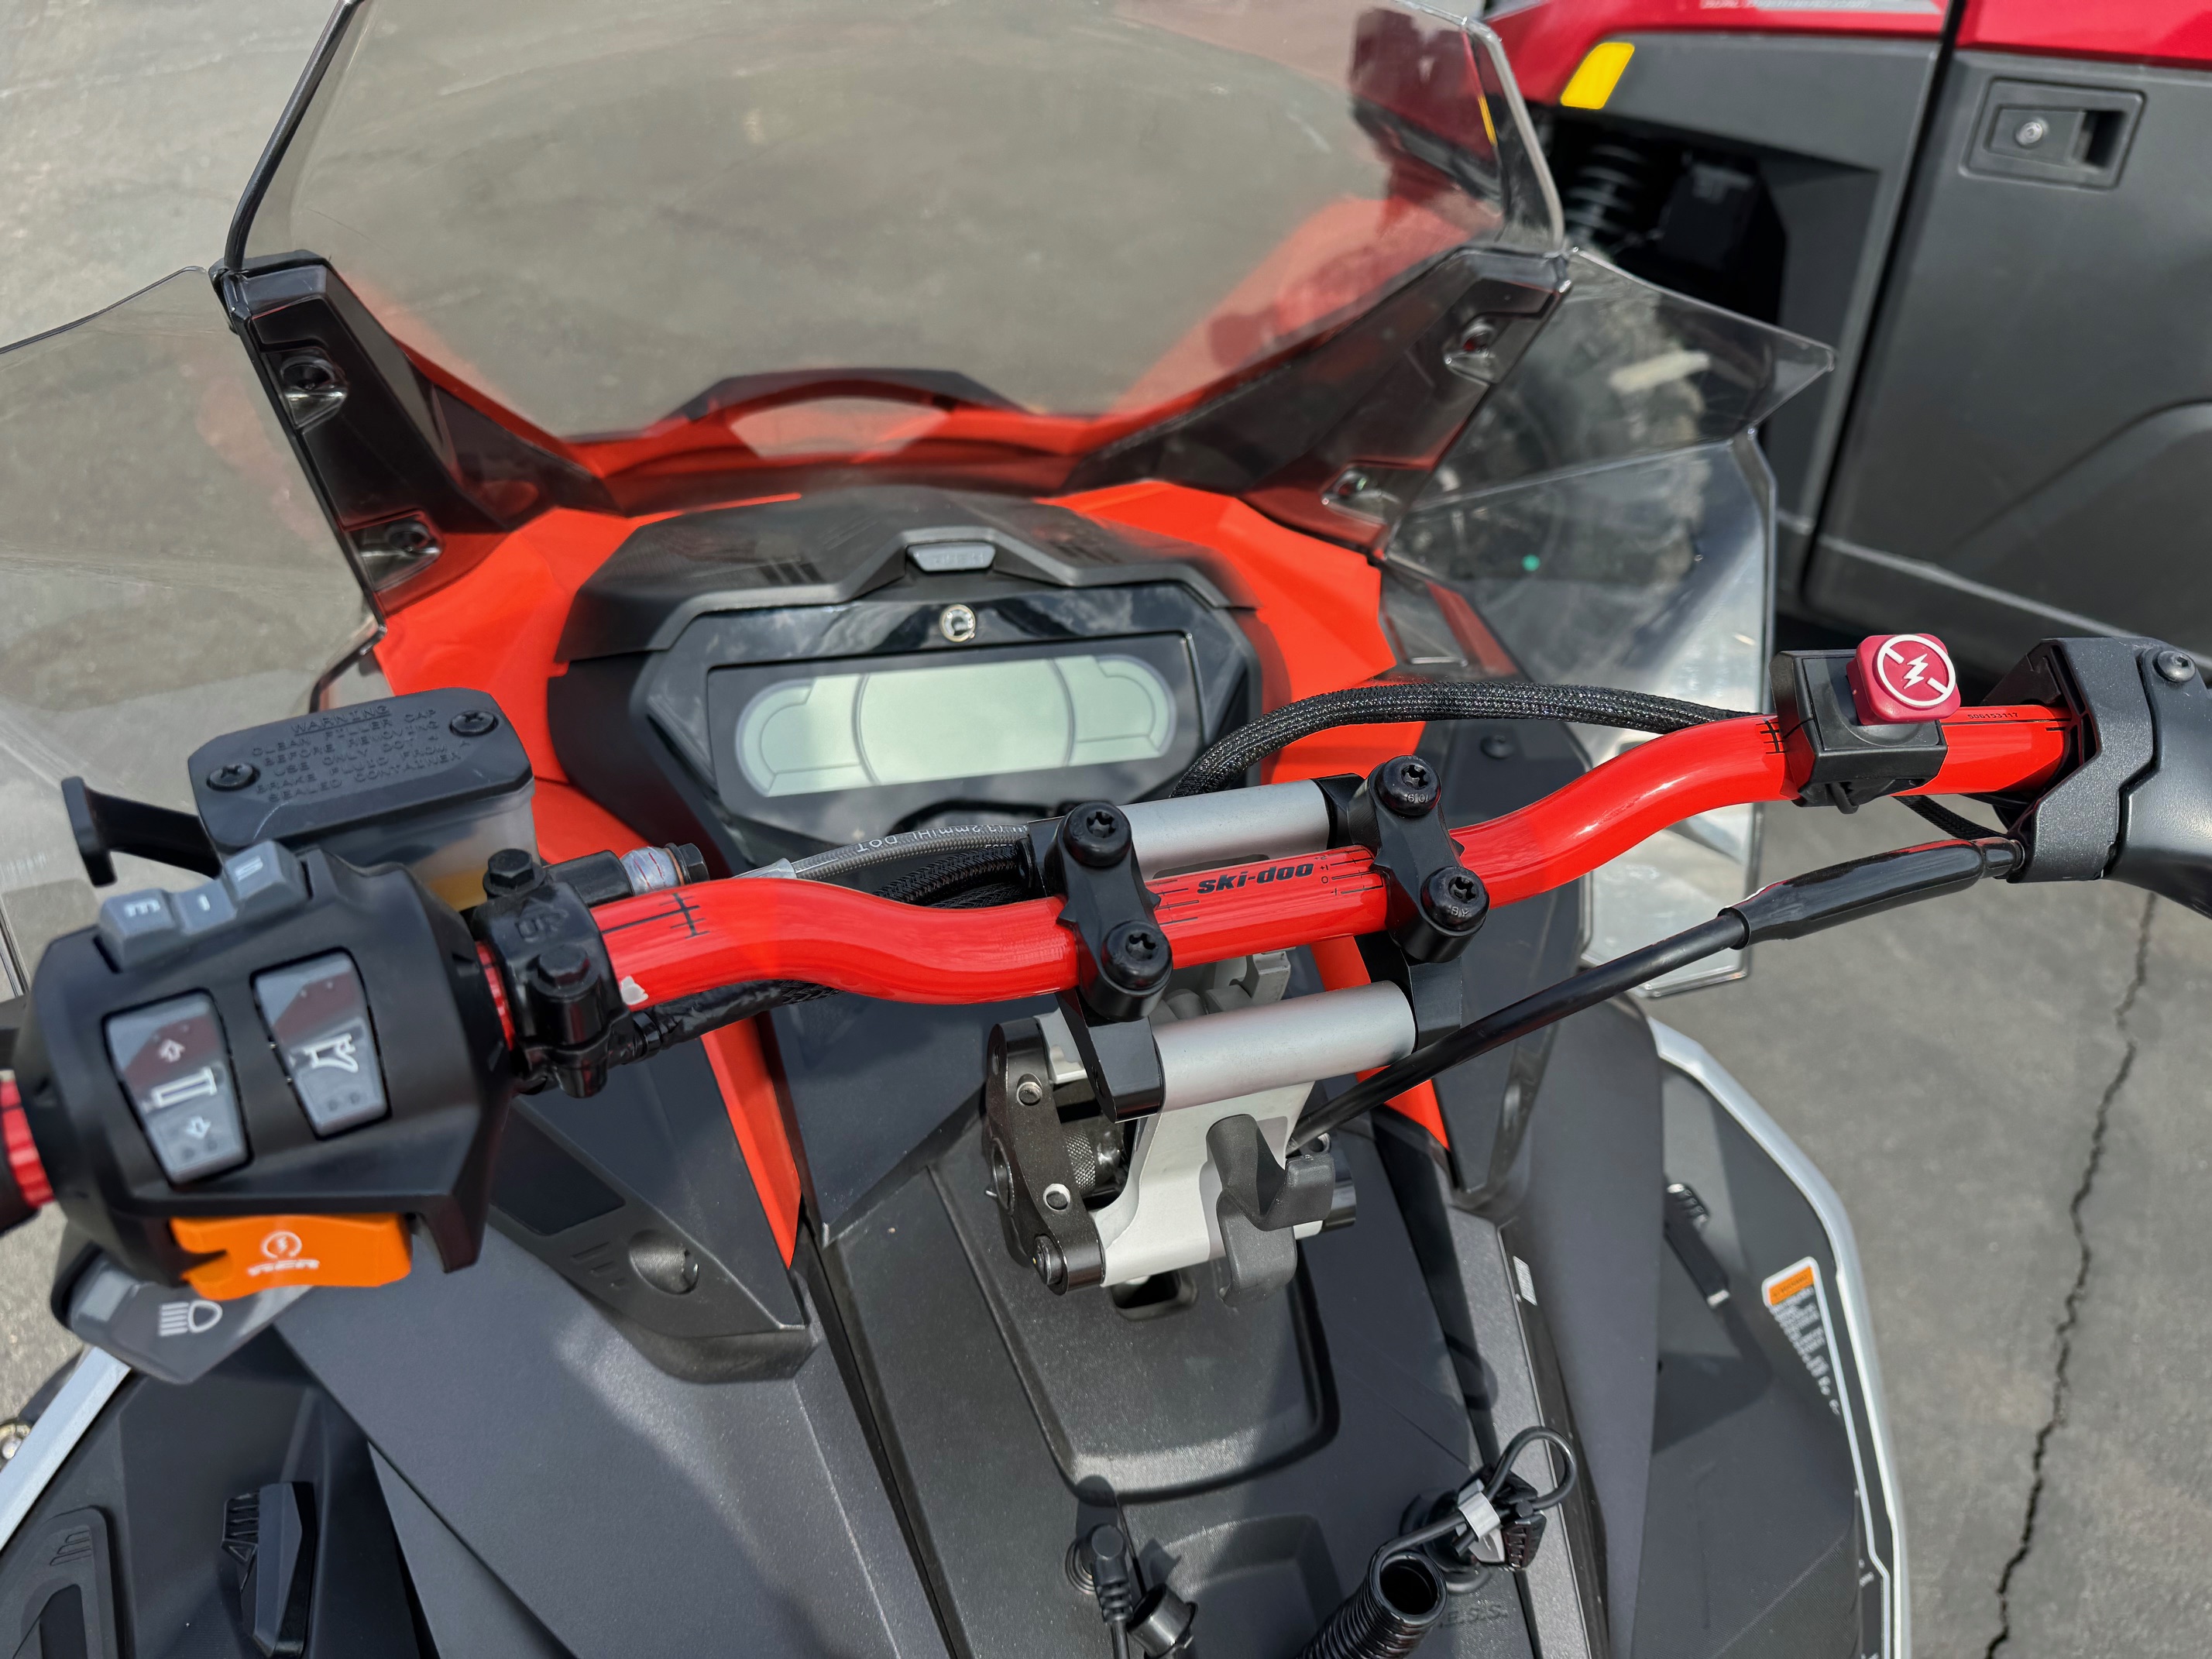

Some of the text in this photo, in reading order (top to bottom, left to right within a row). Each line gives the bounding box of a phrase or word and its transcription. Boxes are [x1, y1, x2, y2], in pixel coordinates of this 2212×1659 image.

[253, 709, 436, 756] CLEAN FILLER CAP
[293, 706, 389, 733] WARNING
[266, 722, 438, 766] BEFORE REMOVING
[275, 762, 310, 776] USE
[324, 750, 367, 765] ONLY
[384, 739, 413, 753] DOT
[258, 775, 316, 794] BRAKE
[331, 757, 389, 776] FLUID
[402, 745, 448, 761] FROM
[270, 753, 462, 803] SEALED CONTAINER
[857, 835, 898, 853] DOT
[1197, 863, 1314, 895] ski-doo
